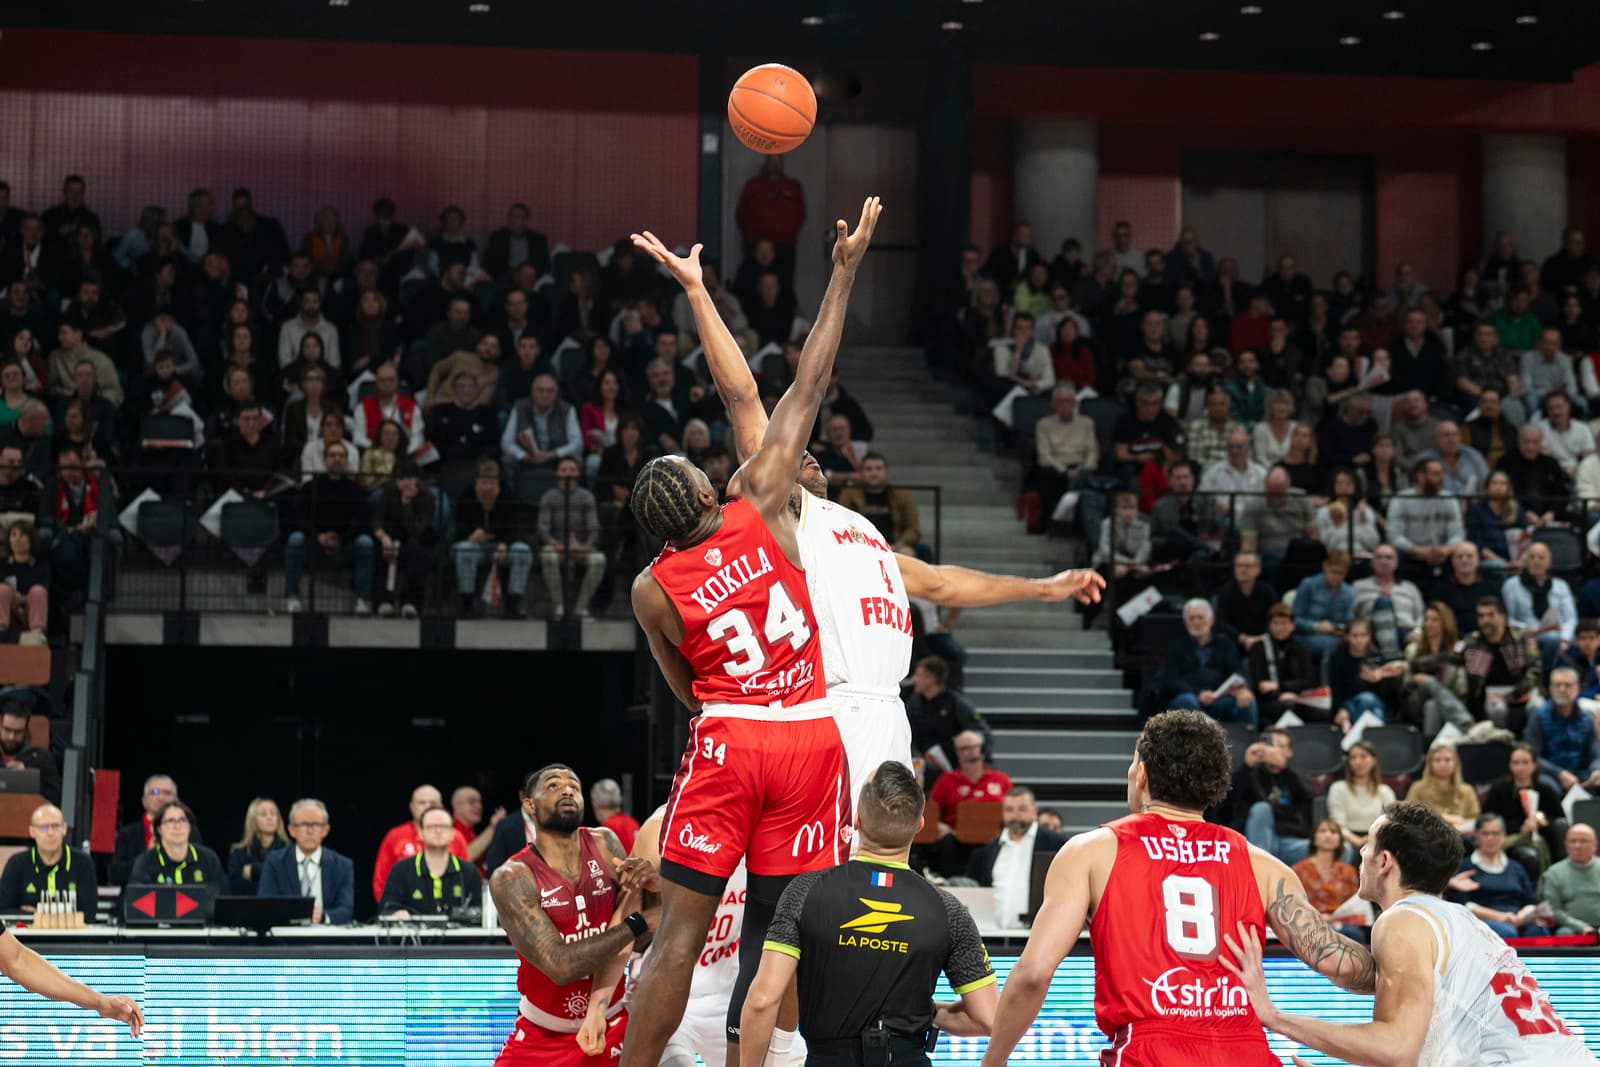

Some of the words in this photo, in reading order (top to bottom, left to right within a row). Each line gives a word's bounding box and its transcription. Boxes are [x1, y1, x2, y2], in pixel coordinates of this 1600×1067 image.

[692, 547, 774, 614] KOKILA
[707, 581, 811, 677] 34
[701, 736, 727, 766] 34
[1140, 836, 1231, 864] USHER
[1162, 874, 1218, 956] 8
[839, 934, 857, 947] LA
[860, 937, 909, 953] POSTE
[1204, 1006, 1213, 1017] &
[47, 1023, 117, 1058] va
[207, 1008, 343, 1057] bien
